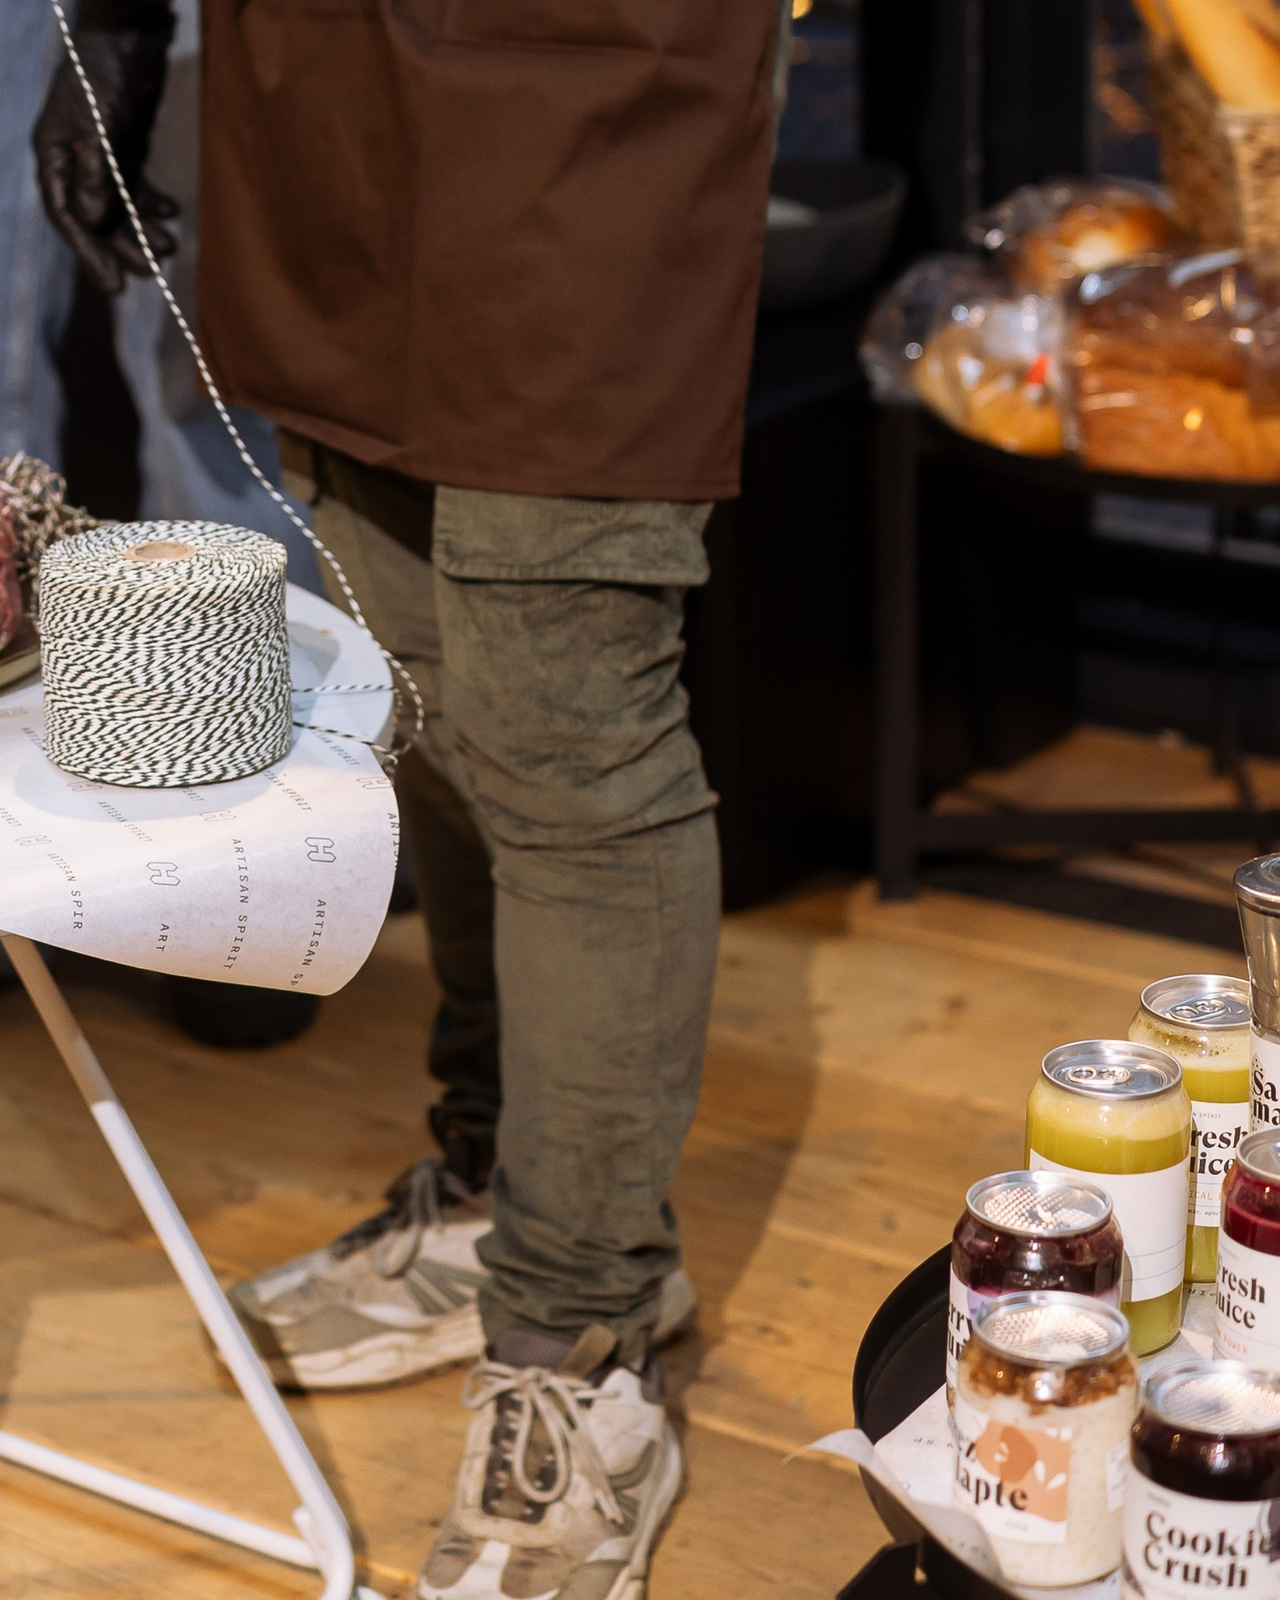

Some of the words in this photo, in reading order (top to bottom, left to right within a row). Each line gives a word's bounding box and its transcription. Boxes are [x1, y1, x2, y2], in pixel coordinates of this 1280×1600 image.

[98, 800, 128, 822] ARTISAN
[124, 823, 153, 842] SPIRIT
[282, 788, 312, 810] SPIRIT
[47, 853, 77, 882] ARTISAN
[71, 890, 83, 929] SPIR
[230, 838, 250, 903] ARTISAN
[155, 923, 170, 952] ART
[223, 914, 248, 970] SPIRIT
[302, 899, 327, 966] ARTISAN
[290, 973, 304, 986] SP
[1190, 1126, 1248, 1149] resh
[1145, 1511, 1272, 1557] Cookie
[1143, 1542, 1248, 1587] Crush
